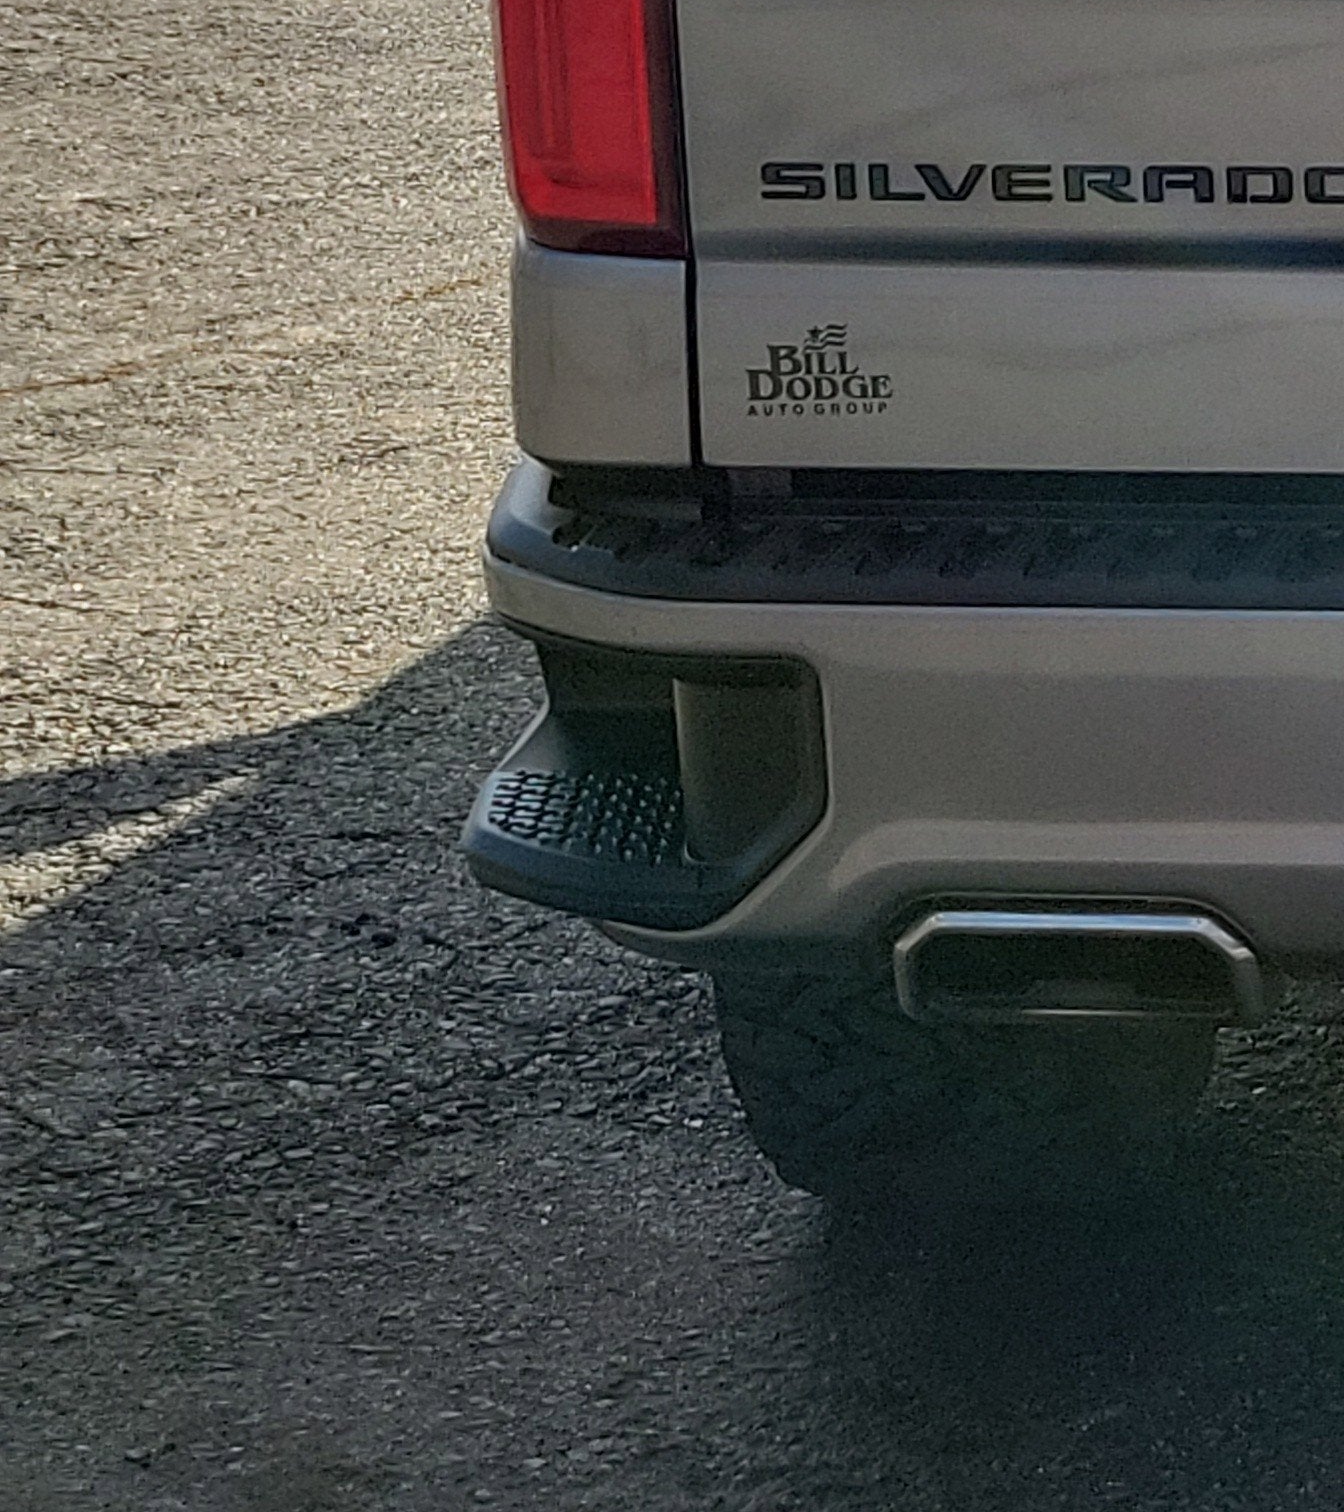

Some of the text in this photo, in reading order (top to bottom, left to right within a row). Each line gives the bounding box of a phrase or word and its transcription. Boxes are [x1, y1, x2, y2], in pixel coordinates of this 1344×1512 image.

[767, 344, 859, 376] BILL
[745, 369, 894, 401] DODGE
[747, 402, 887, 417] AUTO GROUP
